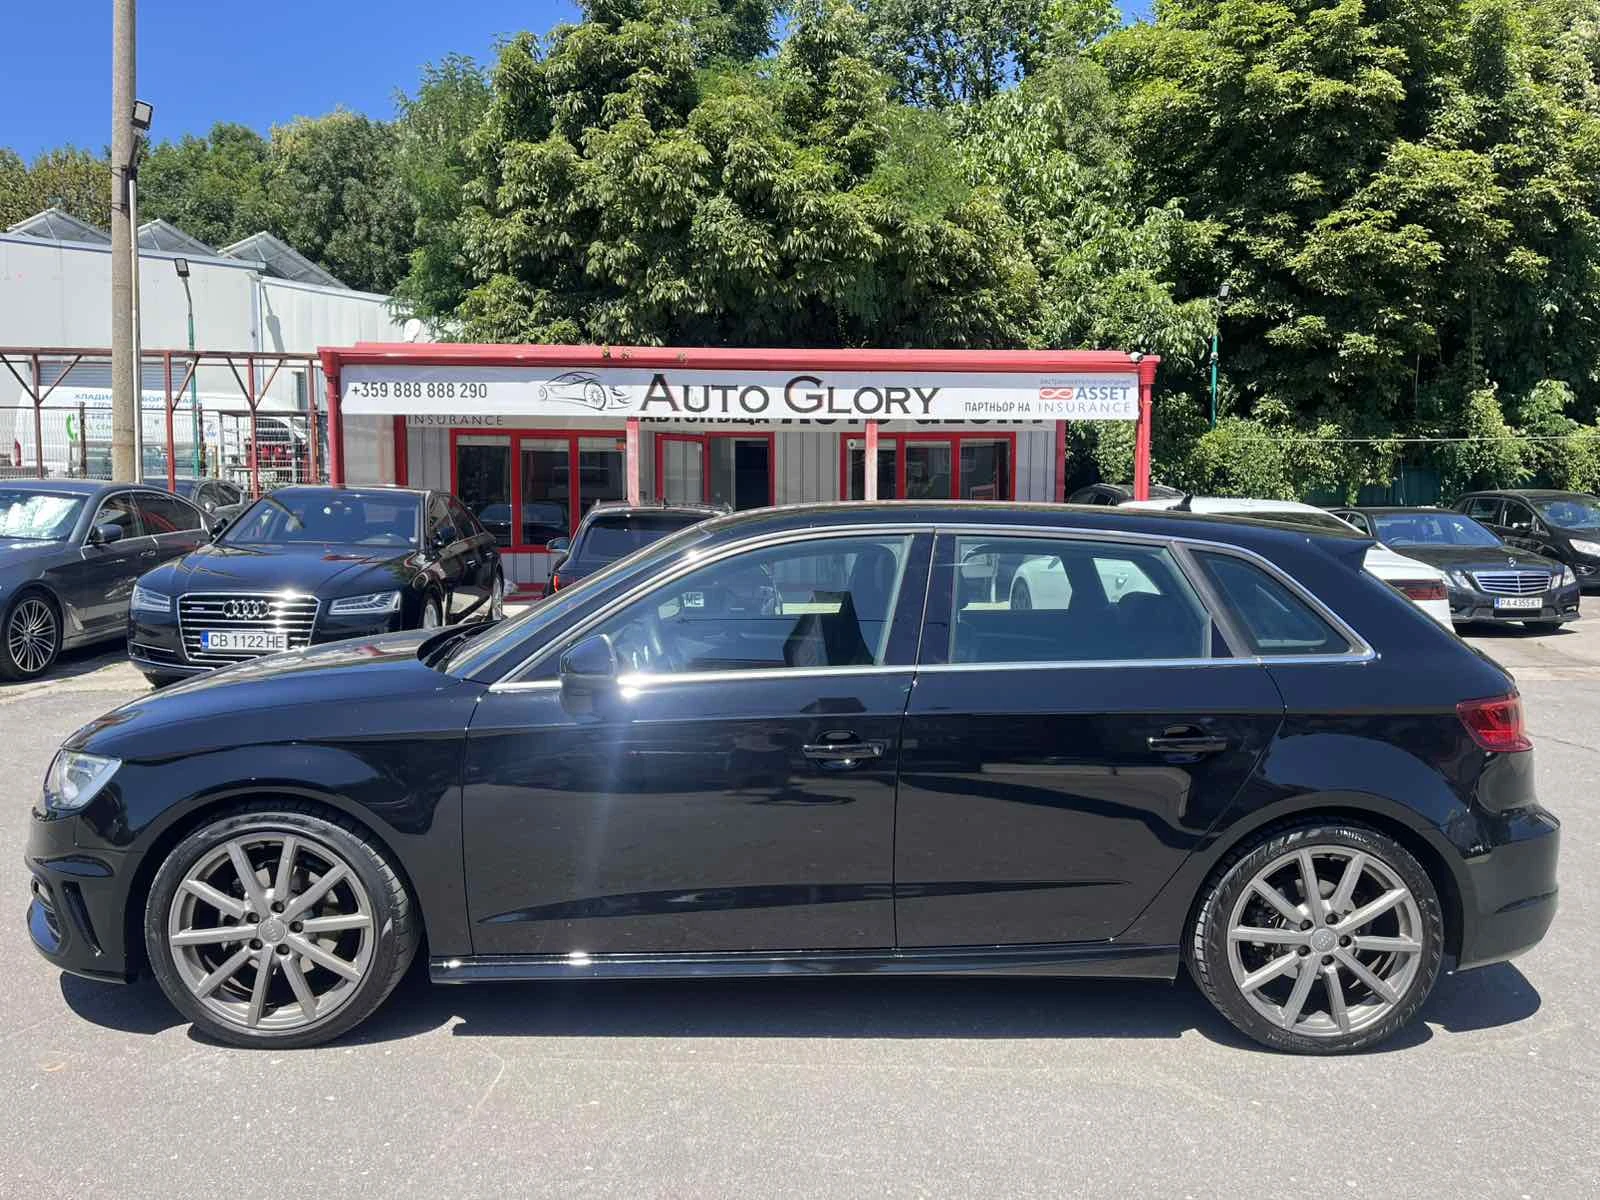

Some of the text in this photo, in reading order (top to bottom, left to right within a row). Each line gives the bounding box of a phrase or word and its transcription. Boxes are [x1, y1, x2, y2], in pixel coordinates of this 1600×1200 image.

[351, 381, 488, 398] +359 888 888 290
[1075, 387, 1130, 400] ASSET
[964, 401, 1031, 413] ПАРТНЬОР НА
[1038, 400, 1131, 414] INSURANCE
[407, 415, 505, 426] INSURANCE
[210, 634, 284, 648] CB 1122 HE
